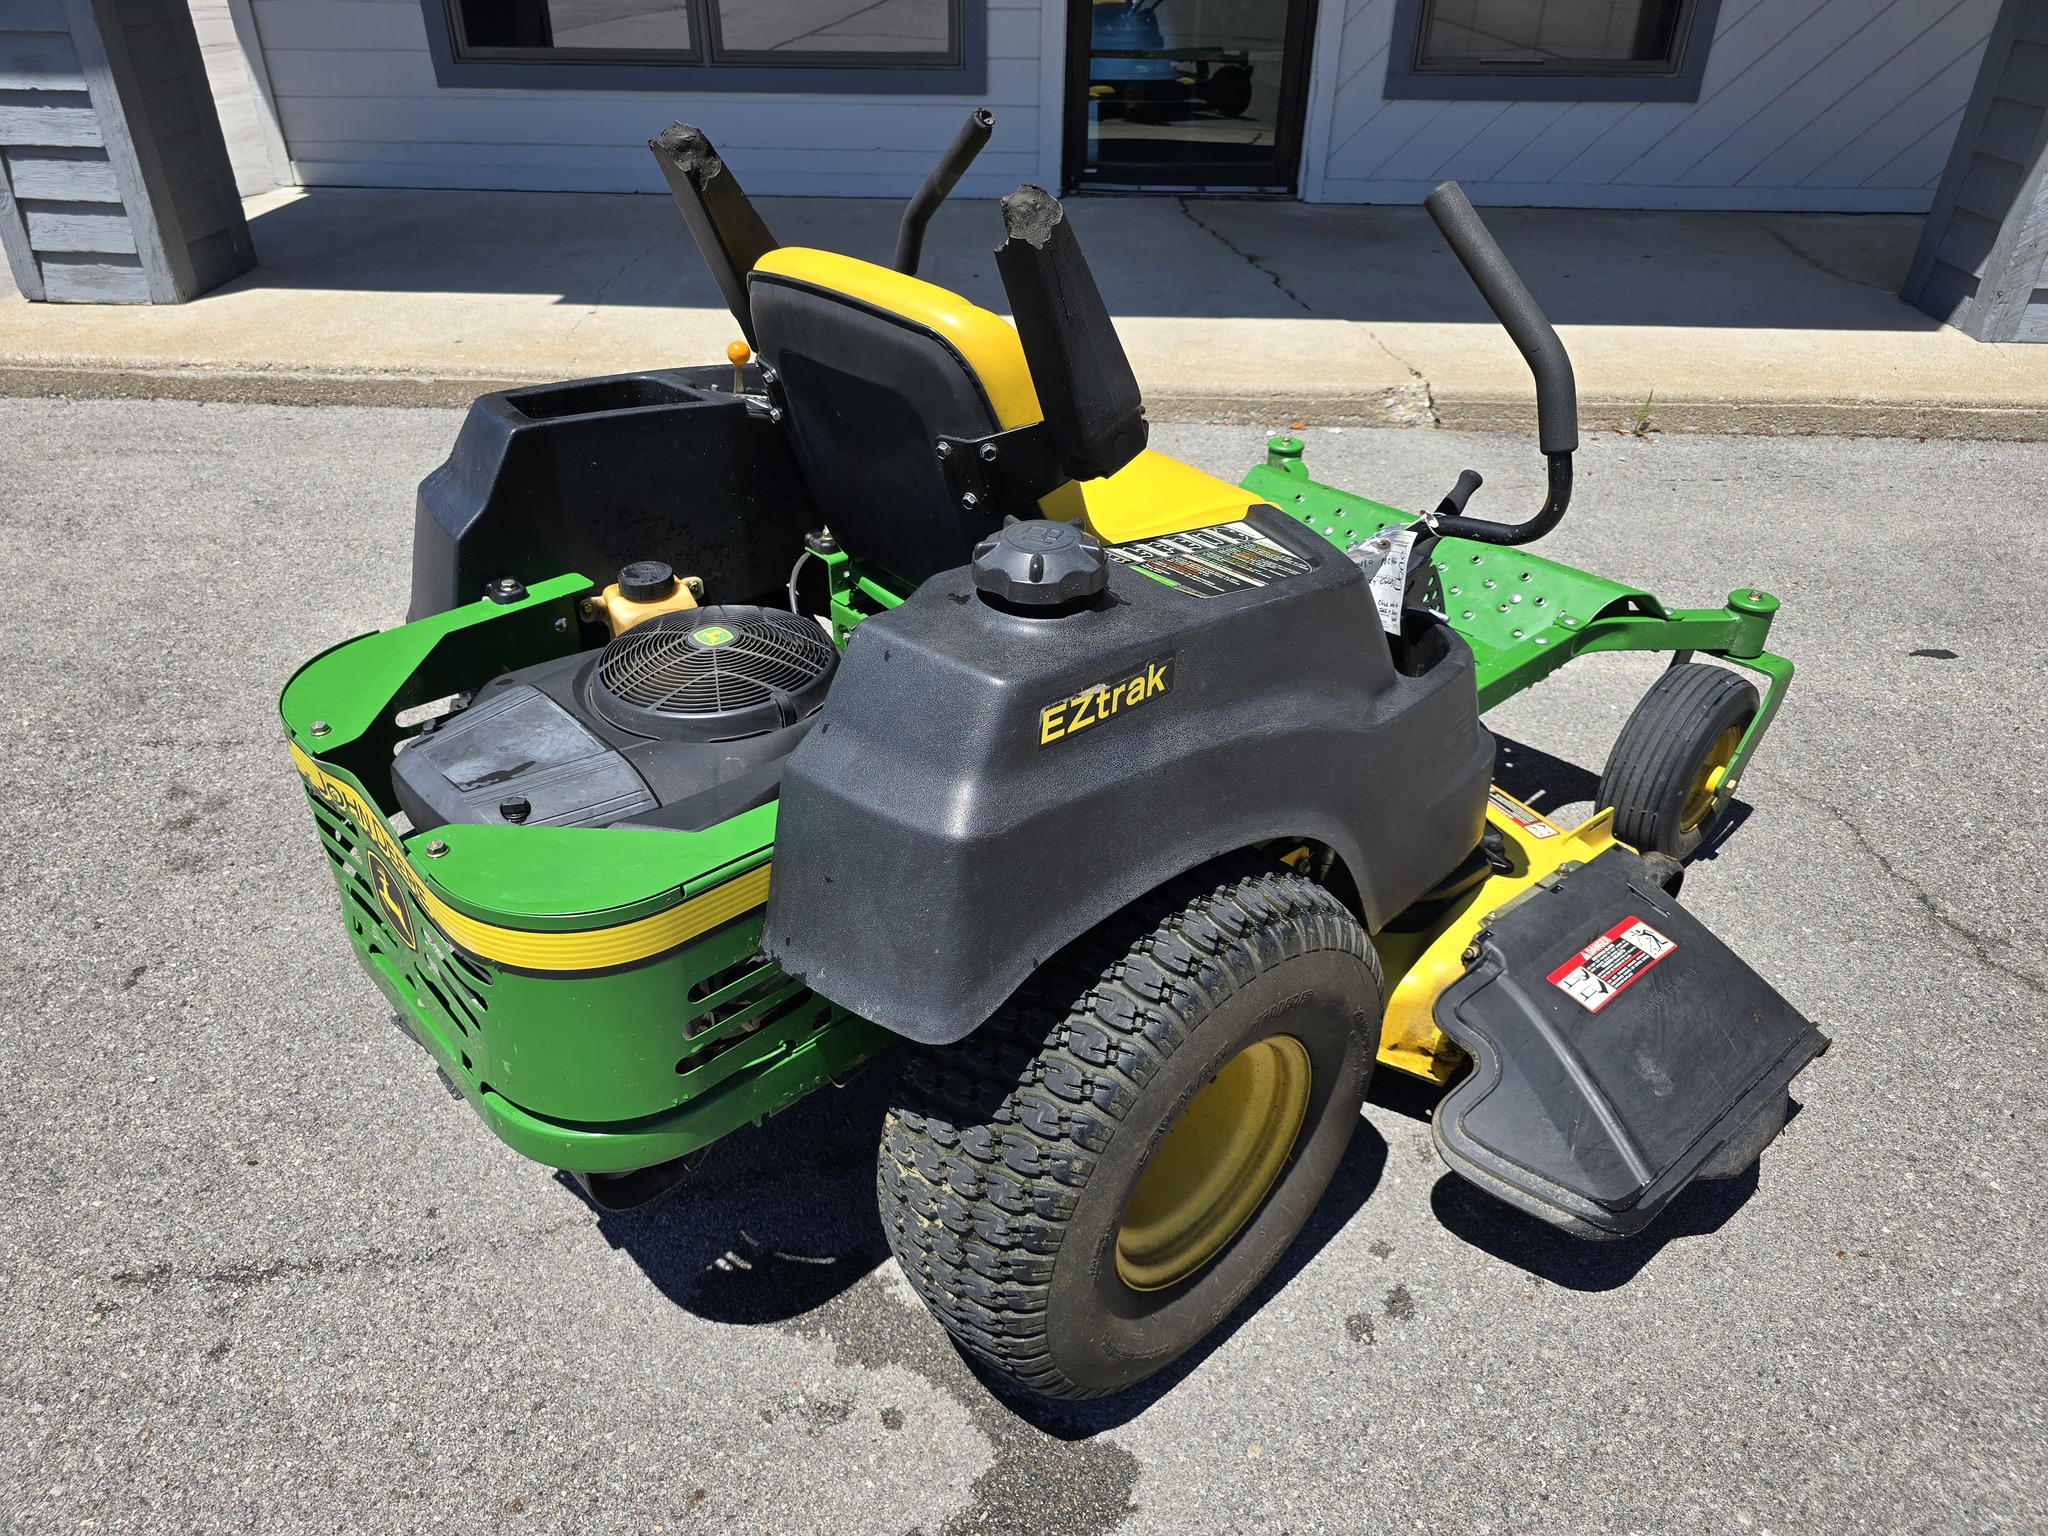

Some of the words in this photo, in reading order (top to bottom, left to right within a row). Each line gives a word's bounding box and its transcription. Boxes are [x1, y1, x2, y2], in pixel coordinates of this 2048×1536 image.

[1041, 663, 1168, 745] EZtrak
[317, 771, 375, 836] JOHN
[371, 816, 431, 912] DEERE
[1584, 935, 1612, 957] DANGER
[1252, 988, 1313, 1032] TURF
